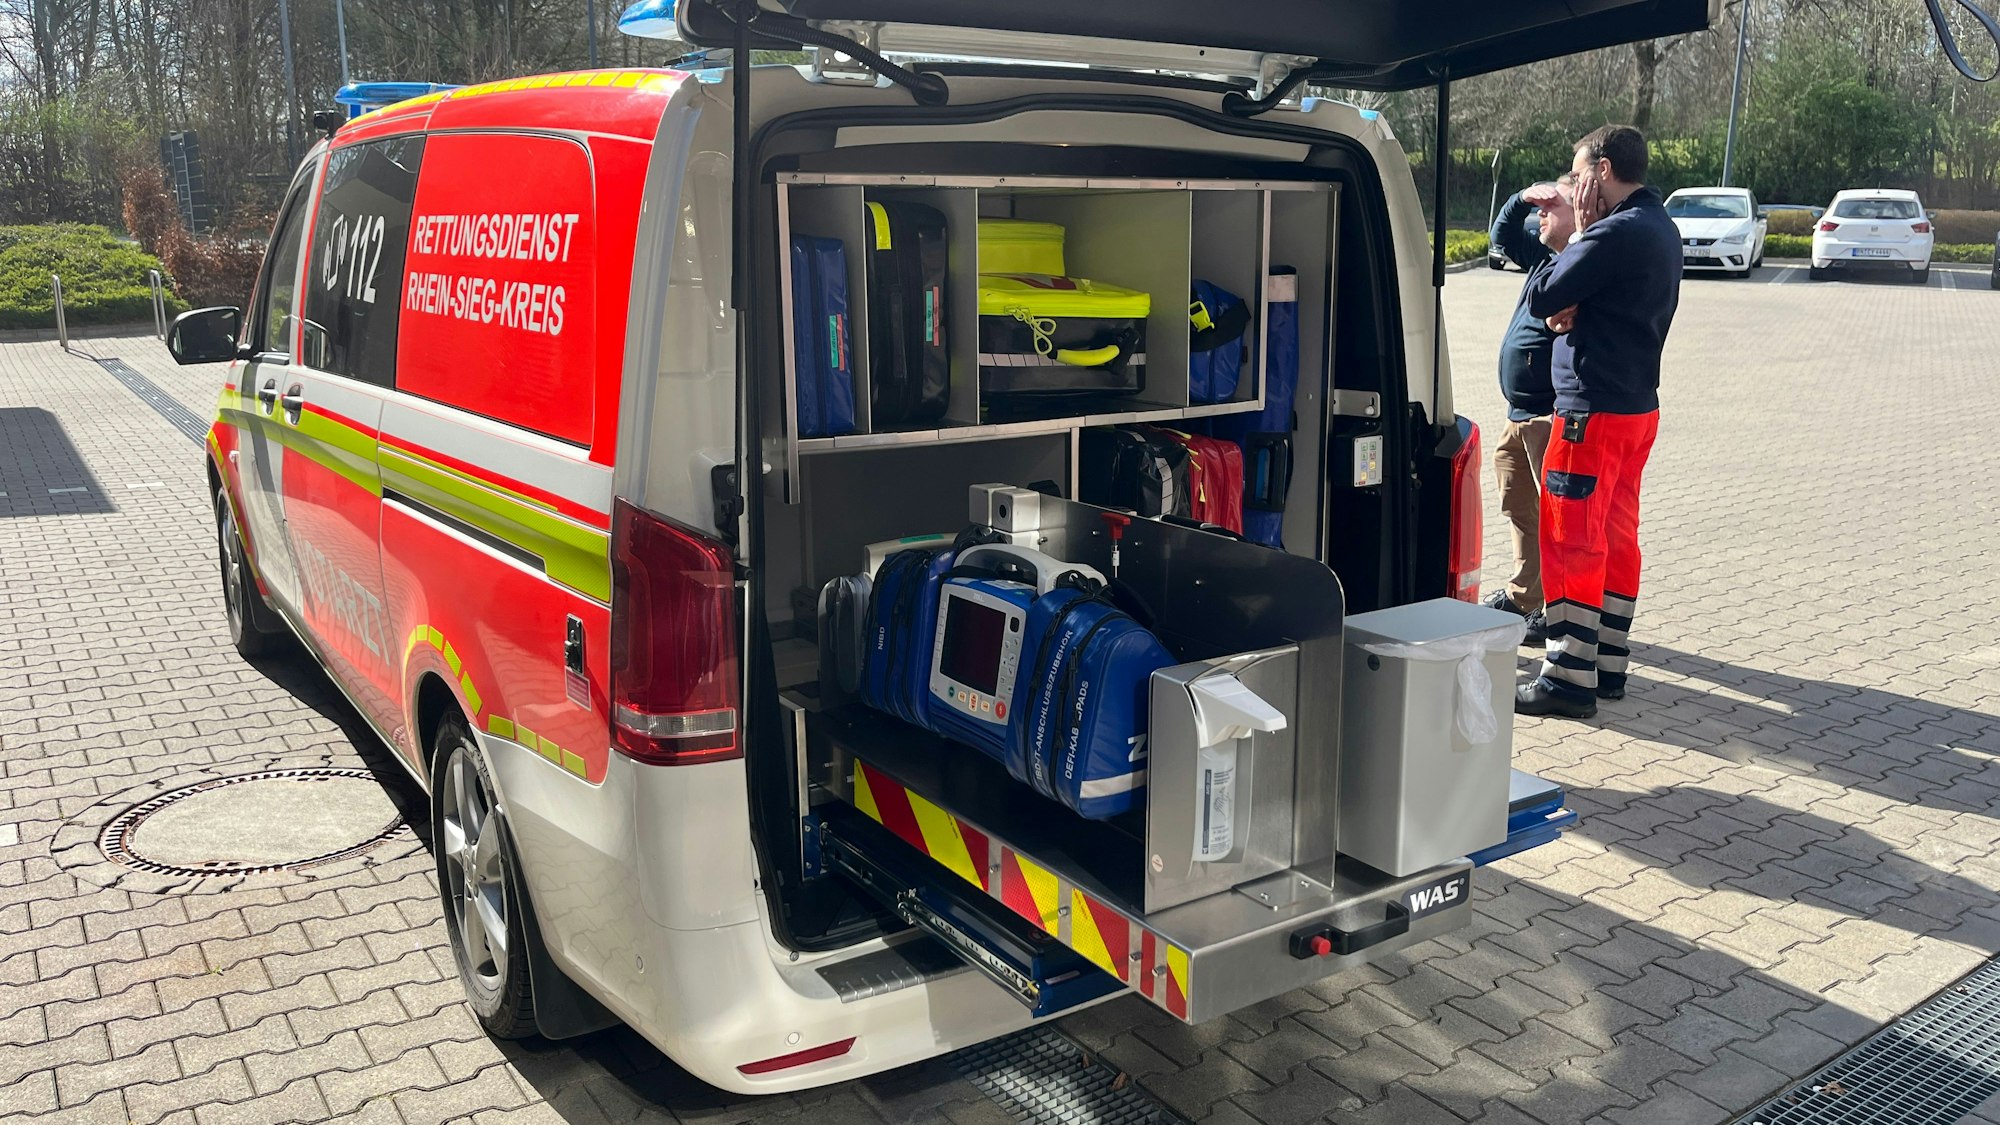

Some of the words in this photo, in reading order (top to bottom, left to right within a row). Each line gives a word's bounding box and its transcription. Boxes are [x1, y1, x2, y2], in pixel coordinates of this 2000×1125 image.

[347, 214, 385, 304] 112
[413, 213, 580, 263] RETTUNGSDIENST
[406, 271, 566, 336] RHEIN-SIEG-KREIS
